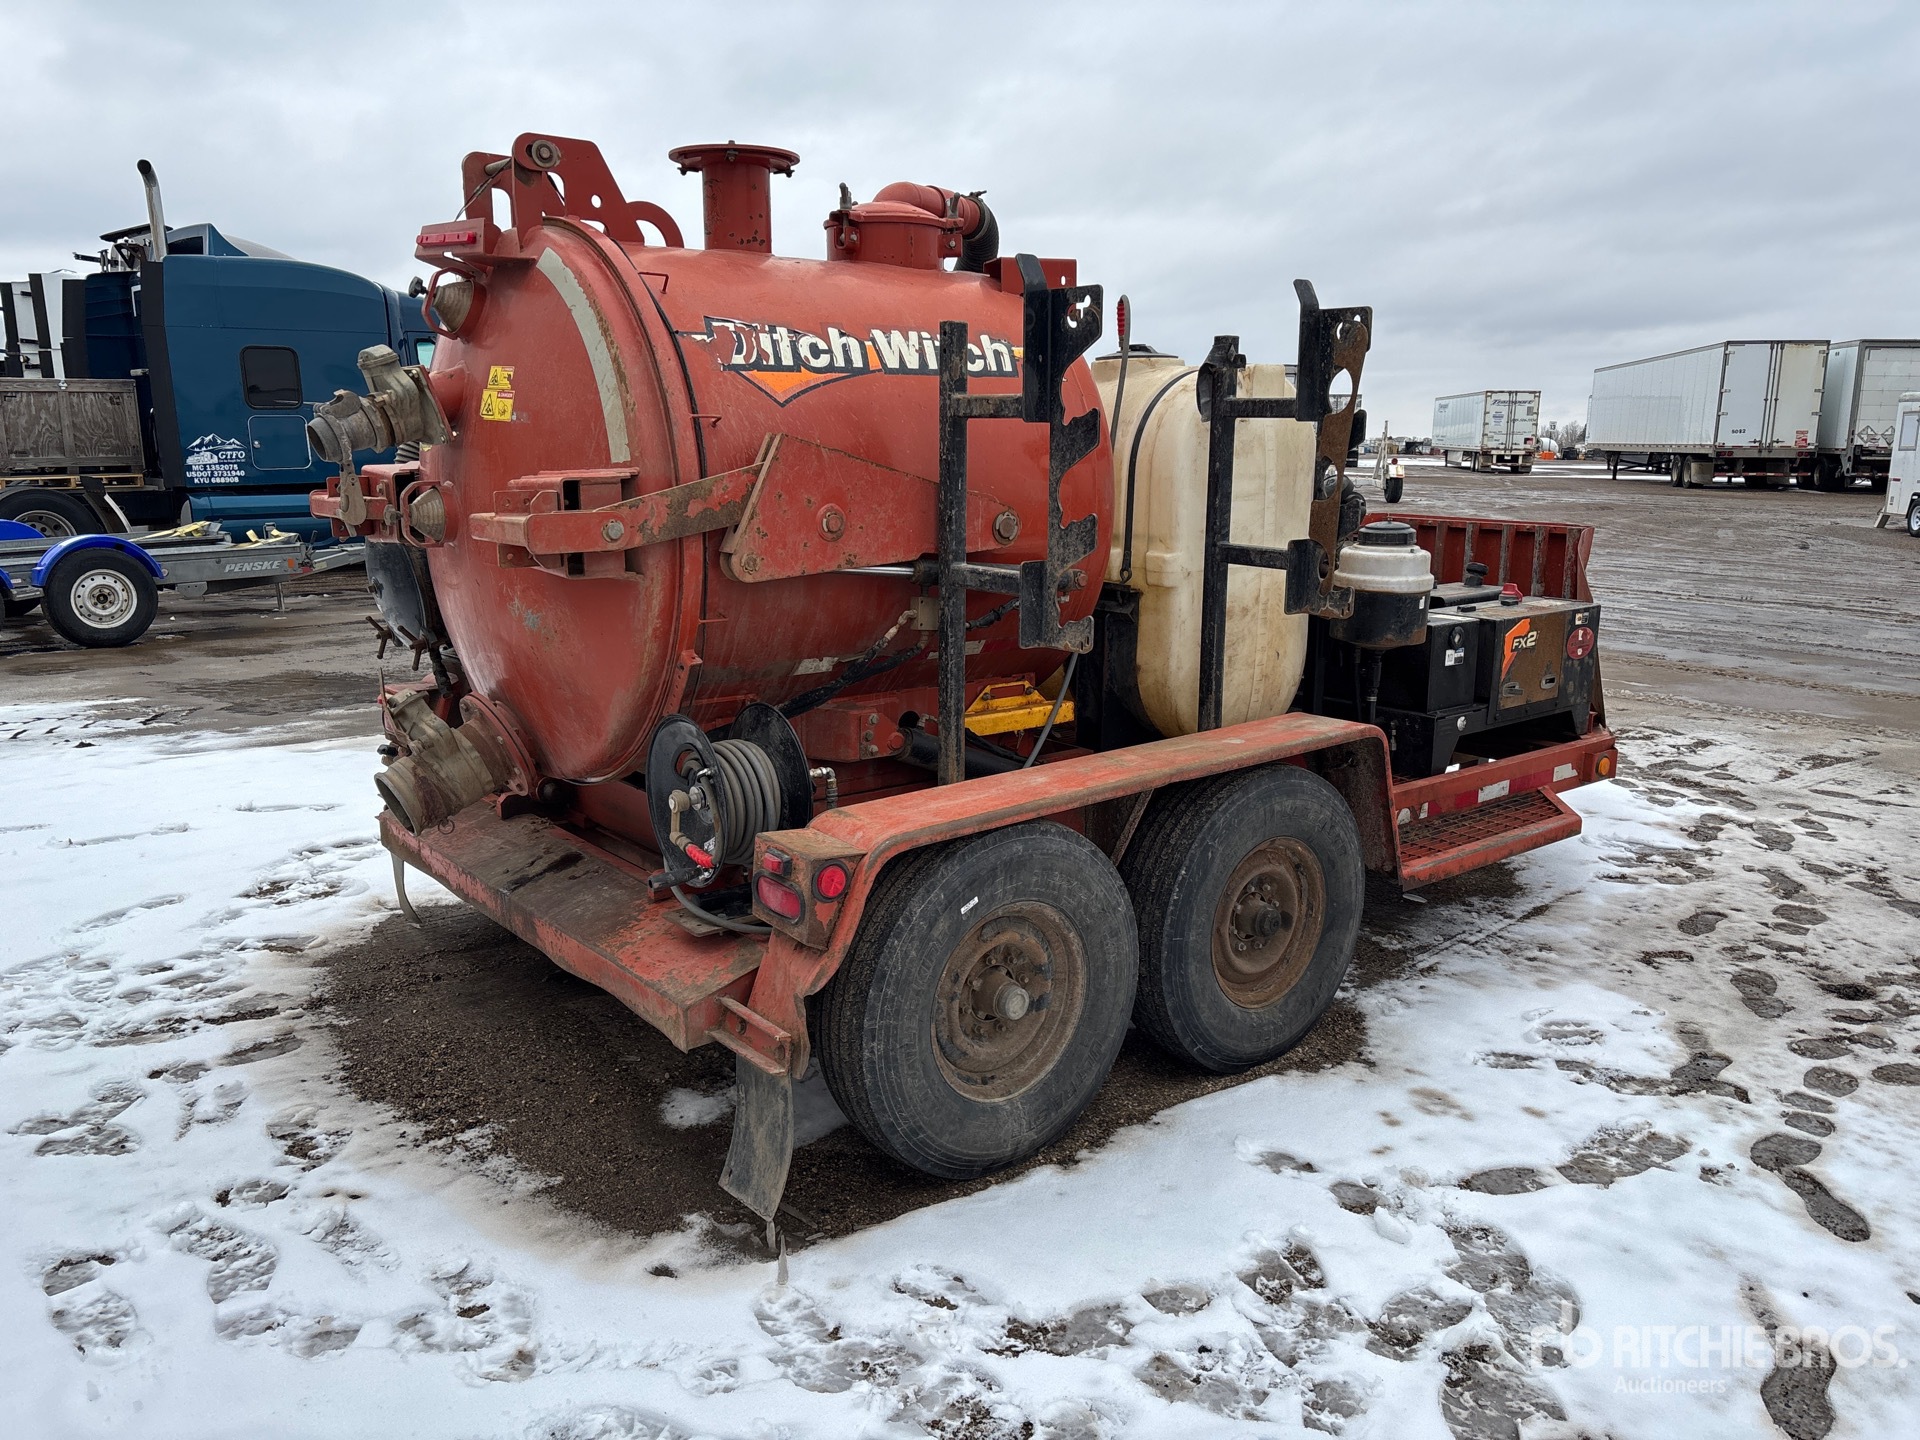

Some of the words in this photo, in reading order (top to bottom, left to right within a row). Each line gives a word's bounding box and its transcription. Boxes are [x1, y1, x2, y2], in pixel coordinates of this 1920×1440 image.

[870, 329, 1013, 372] Wich
[218, 451, 245, 459] GTFO
[224, 560, 282, 573] PENSKE
[1512, 631, 1537, 649] FX2
